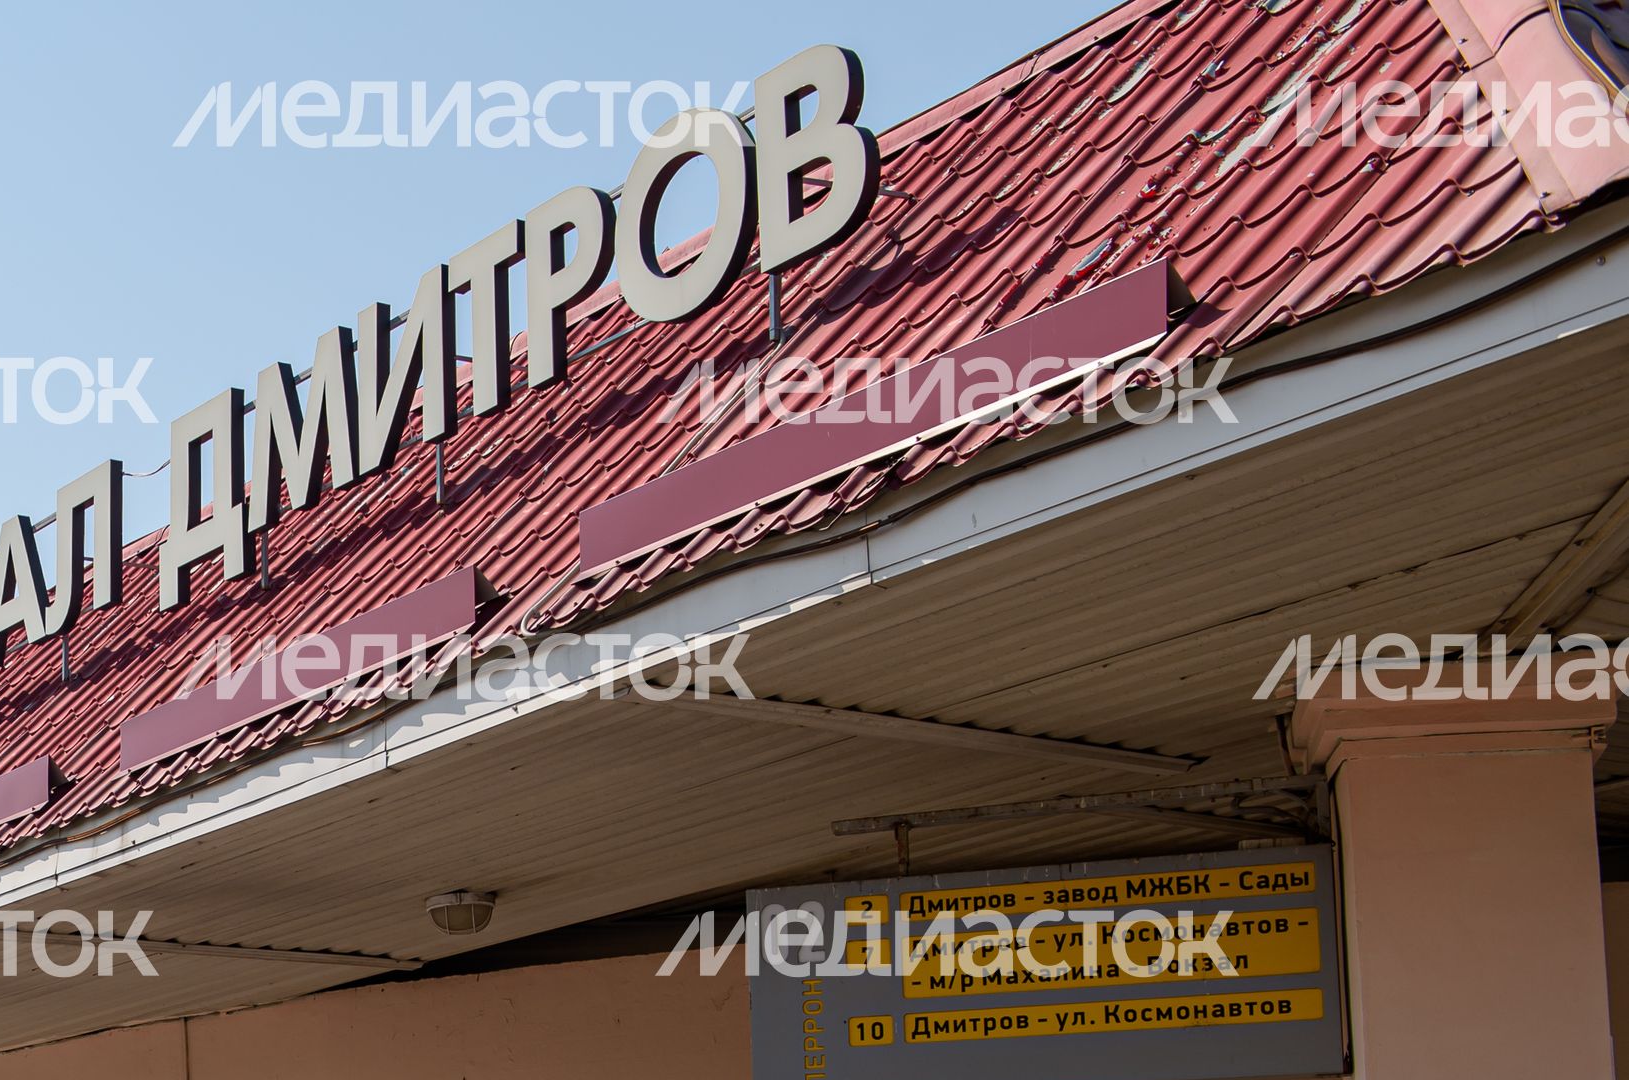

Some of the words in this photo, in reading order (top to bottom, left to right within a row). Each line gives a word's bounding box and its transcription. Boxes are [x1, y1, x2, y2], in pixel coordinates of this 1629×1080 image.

[158, 43, 881, 612] ДМИТРОВ
[860, 901, 873, 919] 2
[908, 891, 1016, 919] Дмитров
[1043, 885, 1118, 904] завод
[1126, 874, 1211, 898] МЖБК
[1239, 870, 1309, 891] Сады
[861, 946, 874, 966] 7
[909, 934, 1028, 962] Дмитров
[1054, 931, 1093, 952] ул.
[1102, 918, 1289, 945] Космонавтов
[930, 968, 974, 992] м/р
[982, 962, 1120, 986] Махалина
[1148, 954, 1248, 975] Вокзал
[857, 1021, 884, 1041] 10
[911, 1013, 1029, 1040] Дмитров
[1055, 1011, 1095, 1031] ул.
[1104, 999, 1292, 1024] Космонавтов
